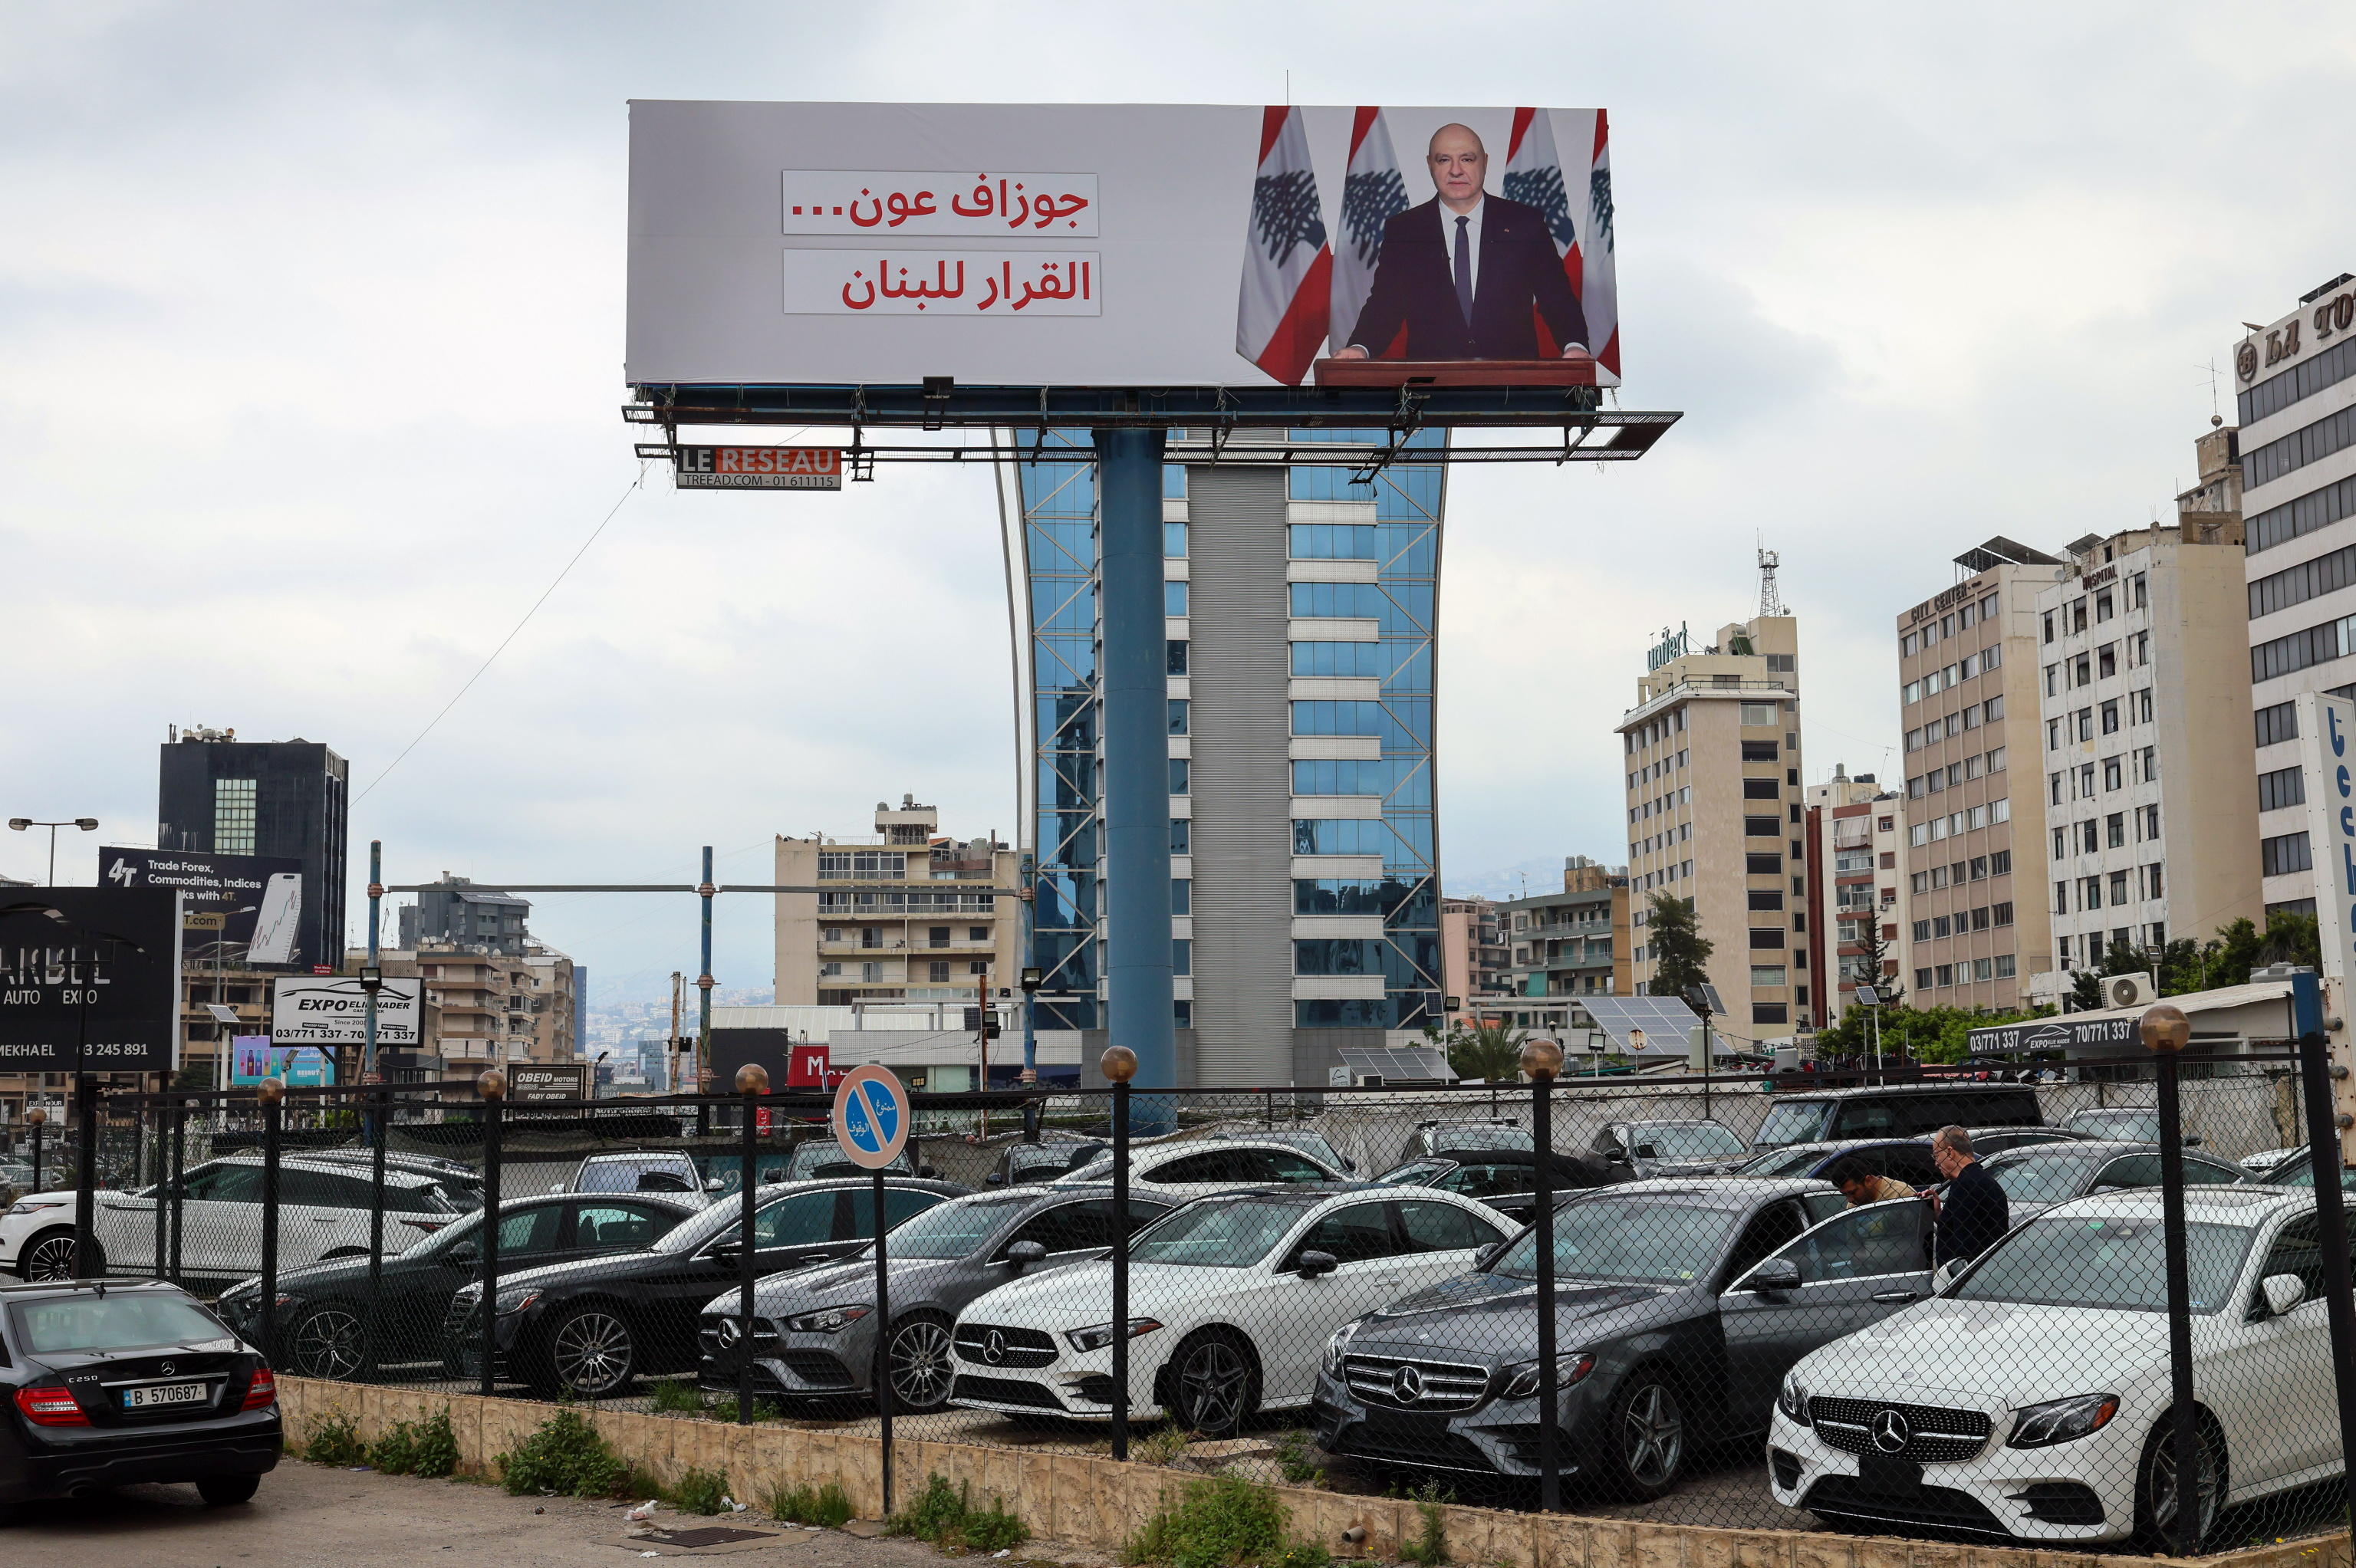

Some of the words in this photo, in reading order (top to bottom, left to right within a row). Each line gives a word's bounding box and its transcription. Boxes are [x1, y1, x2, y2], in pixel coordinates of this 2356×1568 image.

[792, 188, 937, 228] عون...
[951, 173, 1088, 229] جوزاف
[842, 259, 965, 311] للبنان
[976, 261, 1091, 311] القرار
[2265, 318, 2301, 369] LA
[2313, 287, 2356, 340] TO
[683, 449, 712, 472] LE
[722, 449, 834, 473] RESEAU
[684, 474, 762, 486] TREEAD.COM
[772, 476, 785, 486] 01
[790, 476, 834, 487] 611115
[2082, 564, 2117, 591] HOSPITAL
[1911, 600, 1930, 623] CITY
[1933, 582, 1968, 611] CENTER
[1647, 620, 1688, 672] unifert
[147, 859, 179, 871] Trade
[181, 862, 214, 874] Forex,
[147, 873, 223, 889] Commodities,
[224, 878, 262, 889] Indices
[196, 891, 221, 902] with
[221, 892, 237, 902] 4T.
[183, 915, 218, 926] T.com
[3, 990, 41, 1005] AUTO
[298, 998, 348, 1011] EXPO
[275, 1029, 315, 1038] 03/771
[319, 1030, 342, 1039] 337
[393, 1031, 416, 1040] 337
[1969, 1034, 1999, 1052] 03/771
[2002, 1030, 2020, 1048] 337
[2075, 1023, 2108, 1044] 70/771
[2111, 1021, 2131, 1040] 337
[96, 1044, 120, 1056] 245
[123, 1043, 149, 1056] 891
[2030, 1039, 2048, 1048] EXPO
[517, 1073, 553, 1083] OBEID
[848, 1120, 870, 1136] الوقوف
[134, 1390, 143, 1405] B
[150, 1385, 198, 1403] 570687
